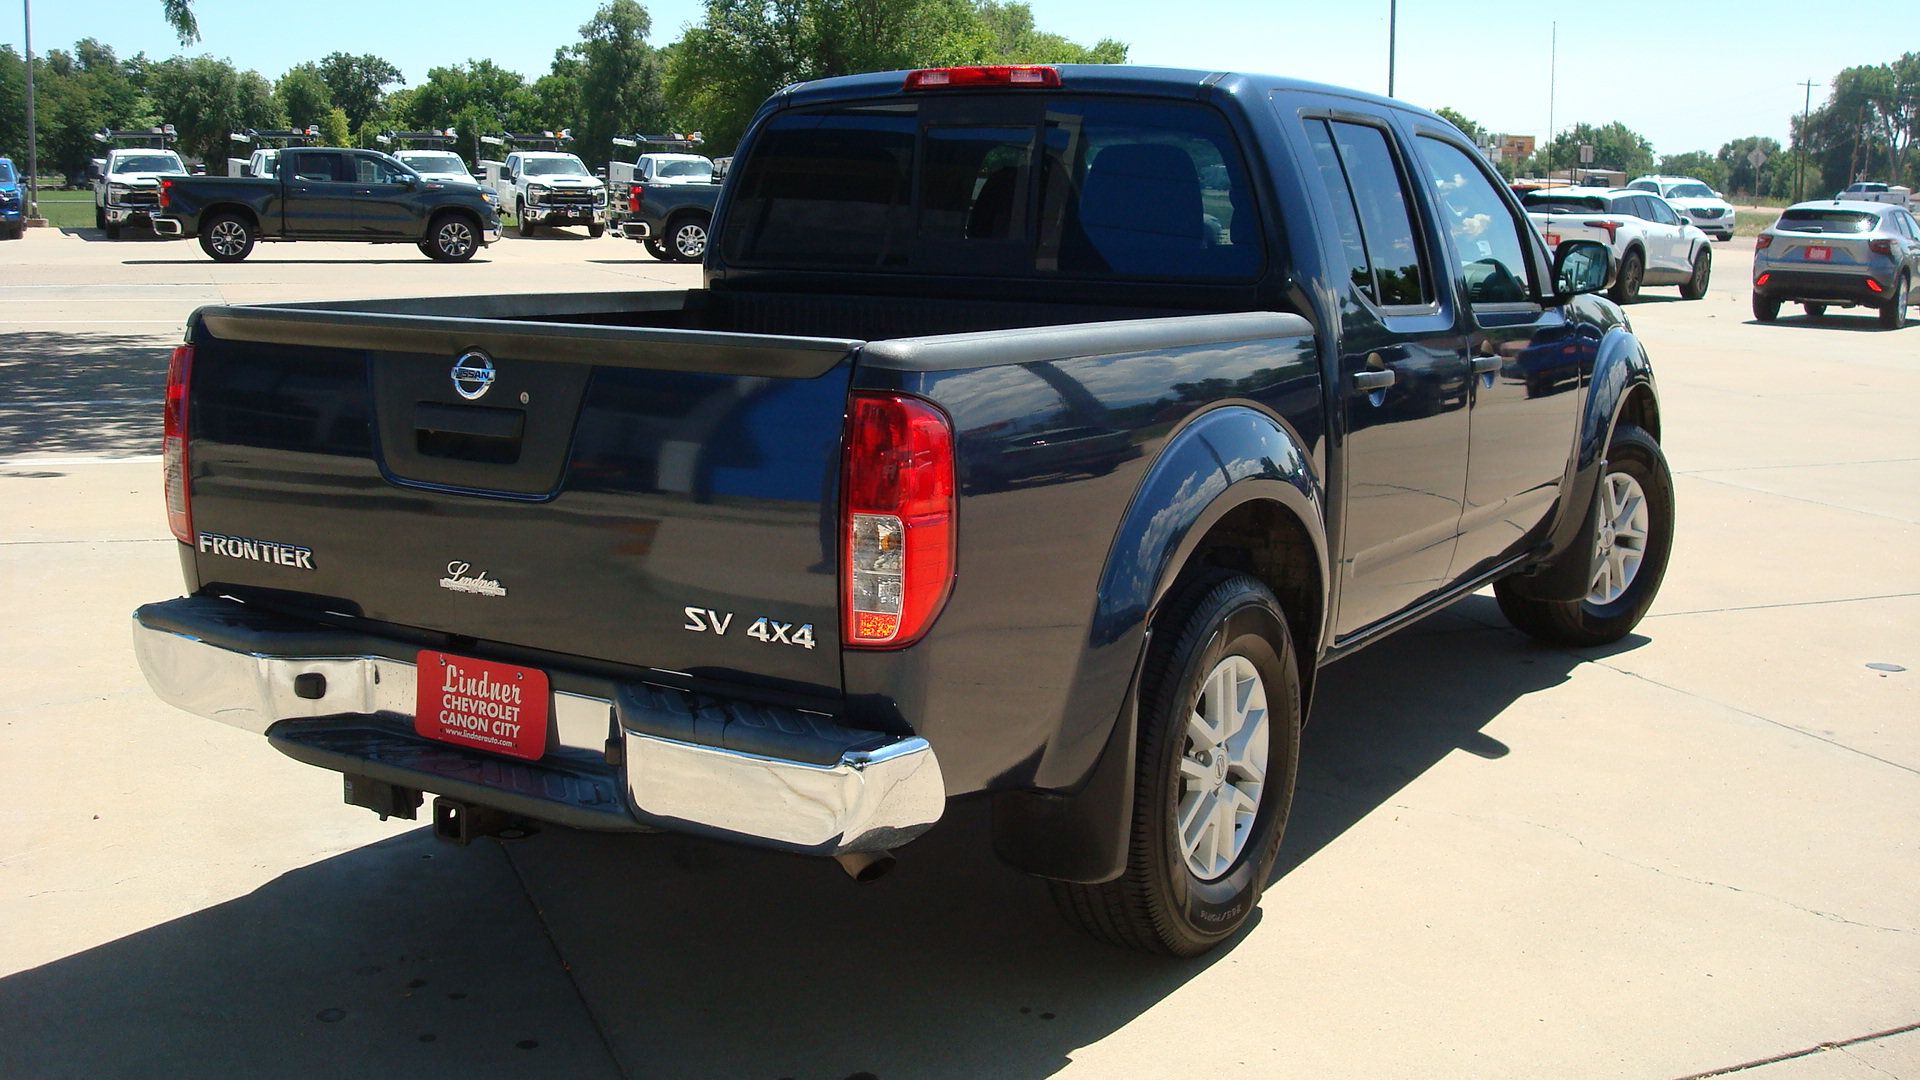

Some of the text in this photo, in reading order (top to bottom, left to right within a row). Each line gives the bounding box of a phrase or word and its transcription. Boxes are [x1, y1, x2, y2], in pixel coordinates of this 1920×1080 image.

[453, 368, 490, 380] NISSAN
[199, 532, 316, 570] FRONTIER
[447, 560, 501, 588] Lindner
[684, 606, 733, 636] SV
[442, 664, 522, 705] Lindner
[442, 694, 520, 722] CHEVROLET
[439, 710, 521, 738] CANON CITY
[445, 727, 513, 748] www.lindnerauto.com
